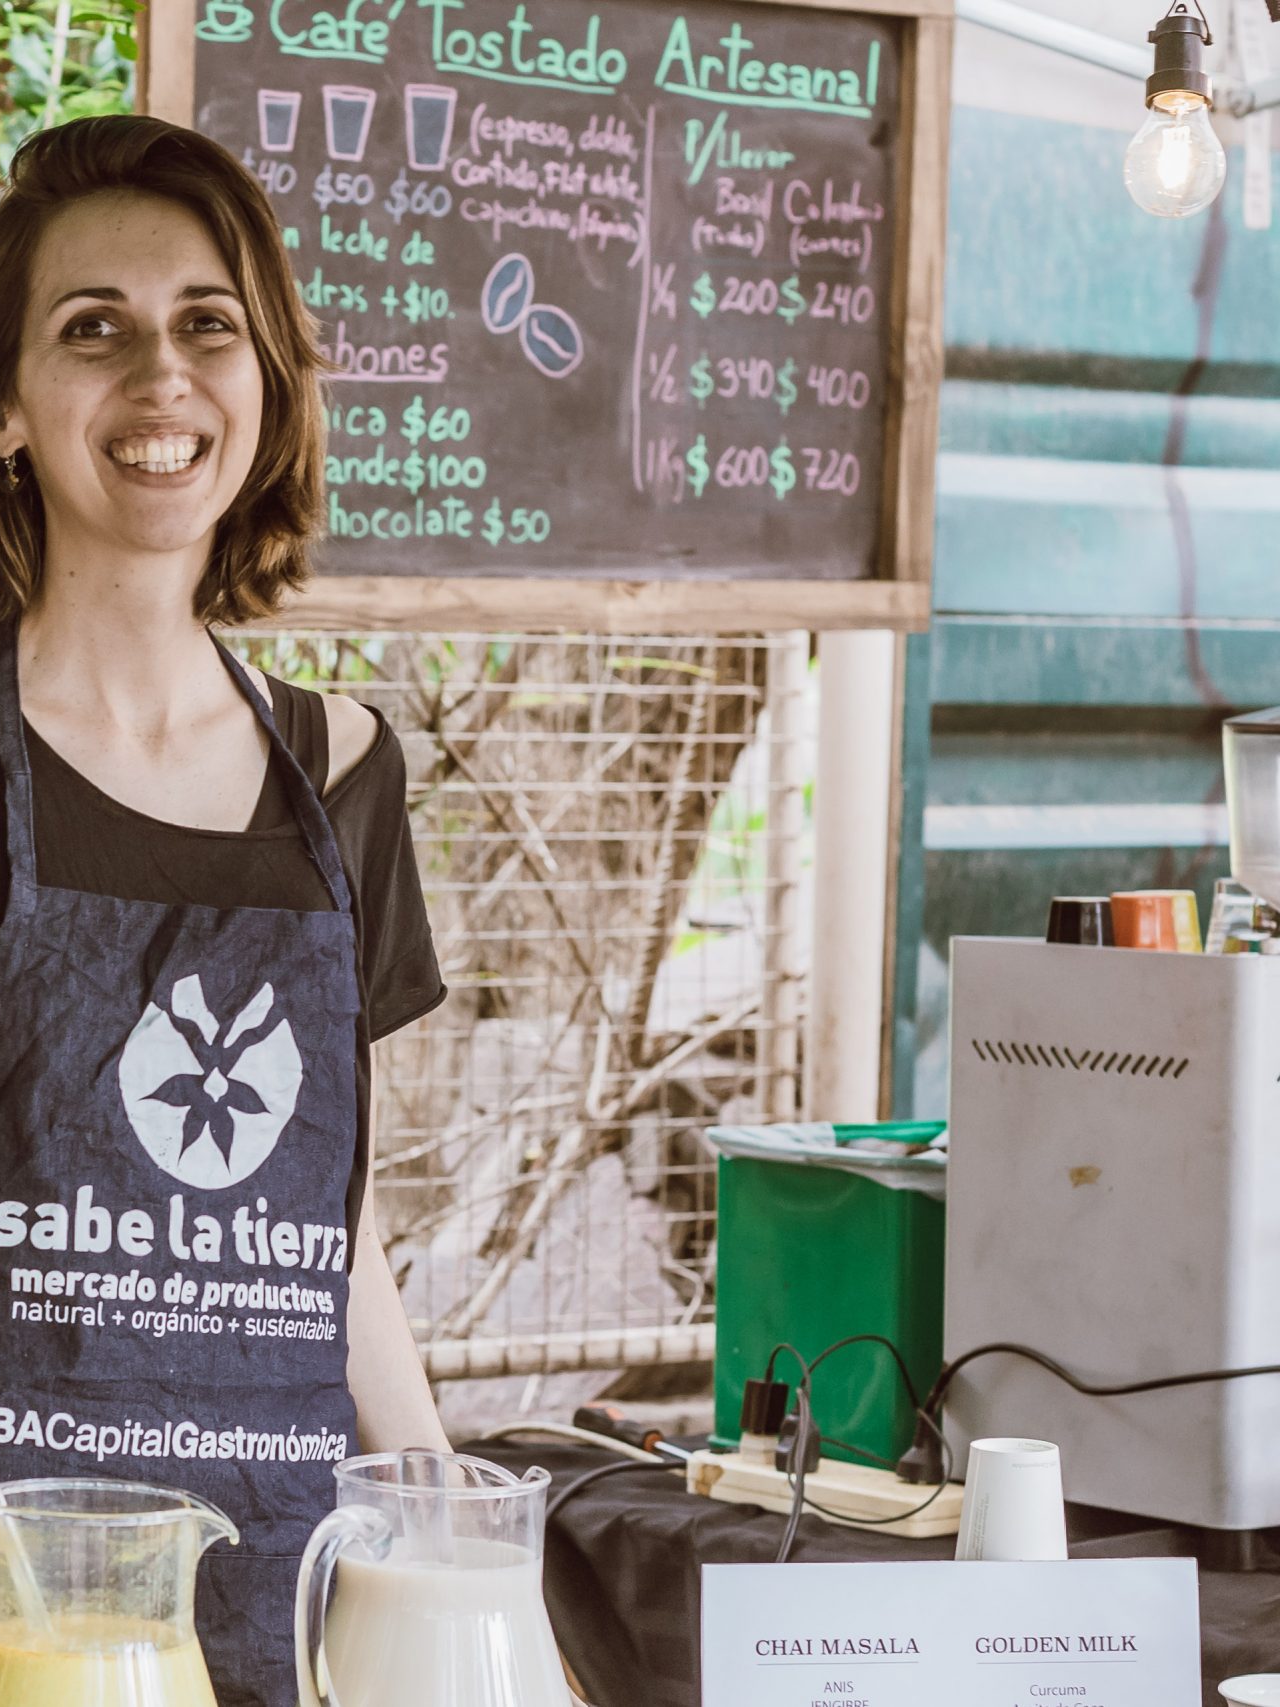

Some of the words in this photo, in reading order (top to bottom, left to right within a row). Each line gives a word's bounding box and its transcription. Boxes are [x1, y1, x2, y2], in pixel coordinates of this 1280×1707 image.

[417, 0, 628, 84] Tostado
[654, 15, 881, 106] Artesanal
[313, 163, 375, 212] $50
[384, 167, 453, 225] $60
[322, 214, 388, 262] leche
[400, 230, 435, 266] de
[400, 394, 471, 446] $60
[325, 443, 401, 486] ande
[400, 449, 488, 495] $100
[330, 490, 474, 540] hocolate
[481, 495, 551, 547] $50
[169, 1193, 222, 1263] la
[231, 1196, 348, 1273] tierra
[10, 1267, 157, 1302] mercado
[163, 1272, 198, 1305] de
[202, 1277, 335, 1315] productores
[11, 1299, 105, 1327] natural
[130, 1305, 222, 1338] orgánico
[244, 1314, 337, 1341] sustentable
[755, 1639, 813, 1656] CHAI
[820, 1637, 921, 1655] MASALA
[975, 1636, 1071, 1654] GOLDEN
[1078, 1634, 1138, 1652] MILK
[823, 1680, 855, 1694] ANIS
[1029, 1684, 1087, 1697] Curcuma
